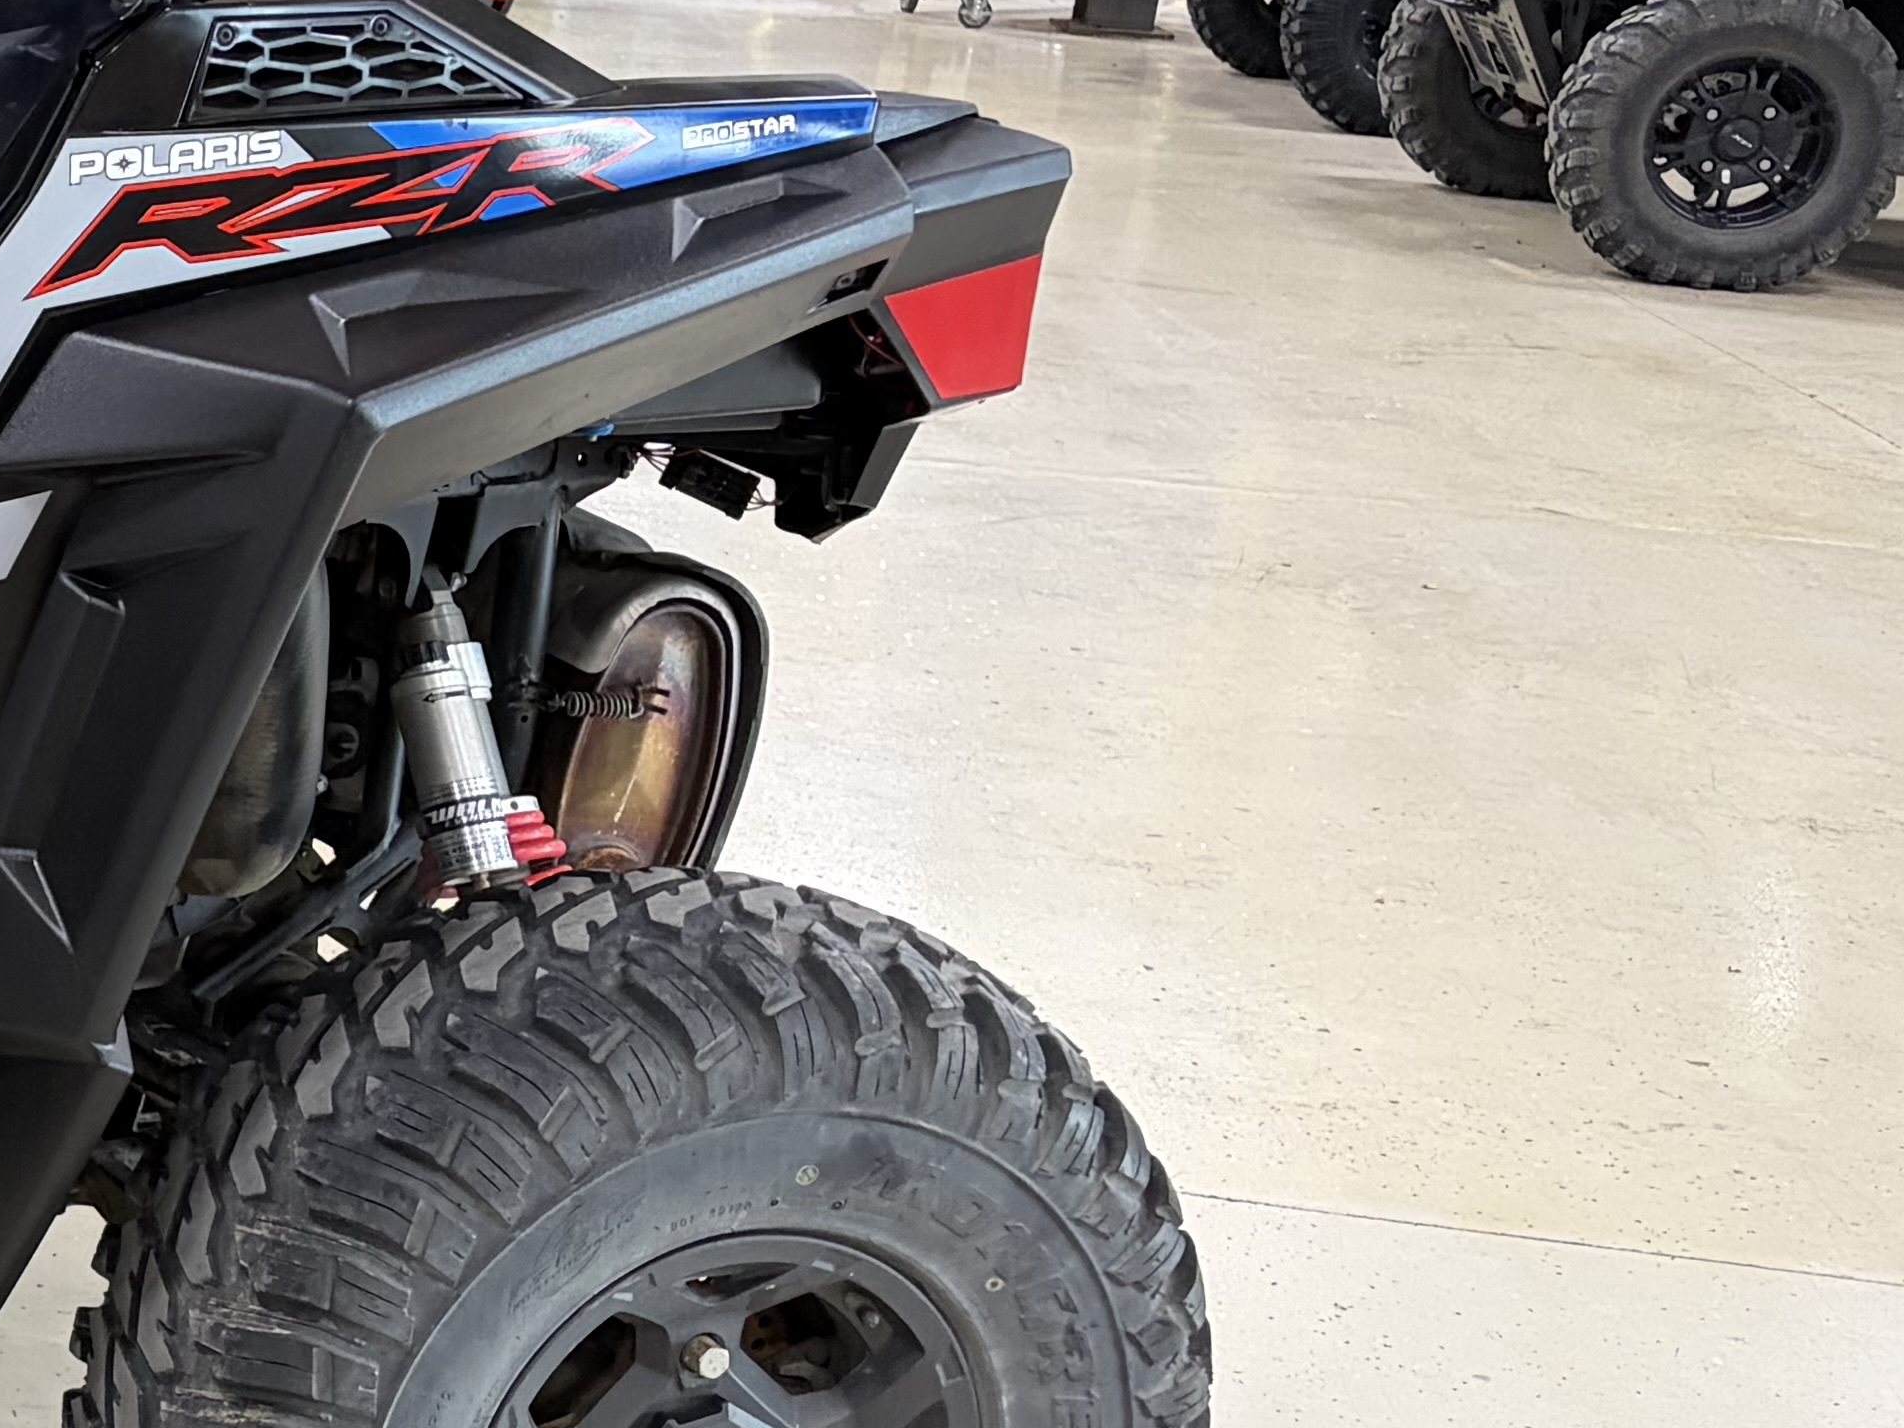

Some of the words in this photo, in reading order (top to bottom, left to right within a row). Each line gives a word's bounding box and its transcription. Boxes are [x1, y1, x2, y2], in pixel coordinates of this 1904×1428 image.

[68, 129, 282, 186] POLARIS
[682, 114, 797, 150] PROSTAR
[24, 117, 655, 300] RZR
